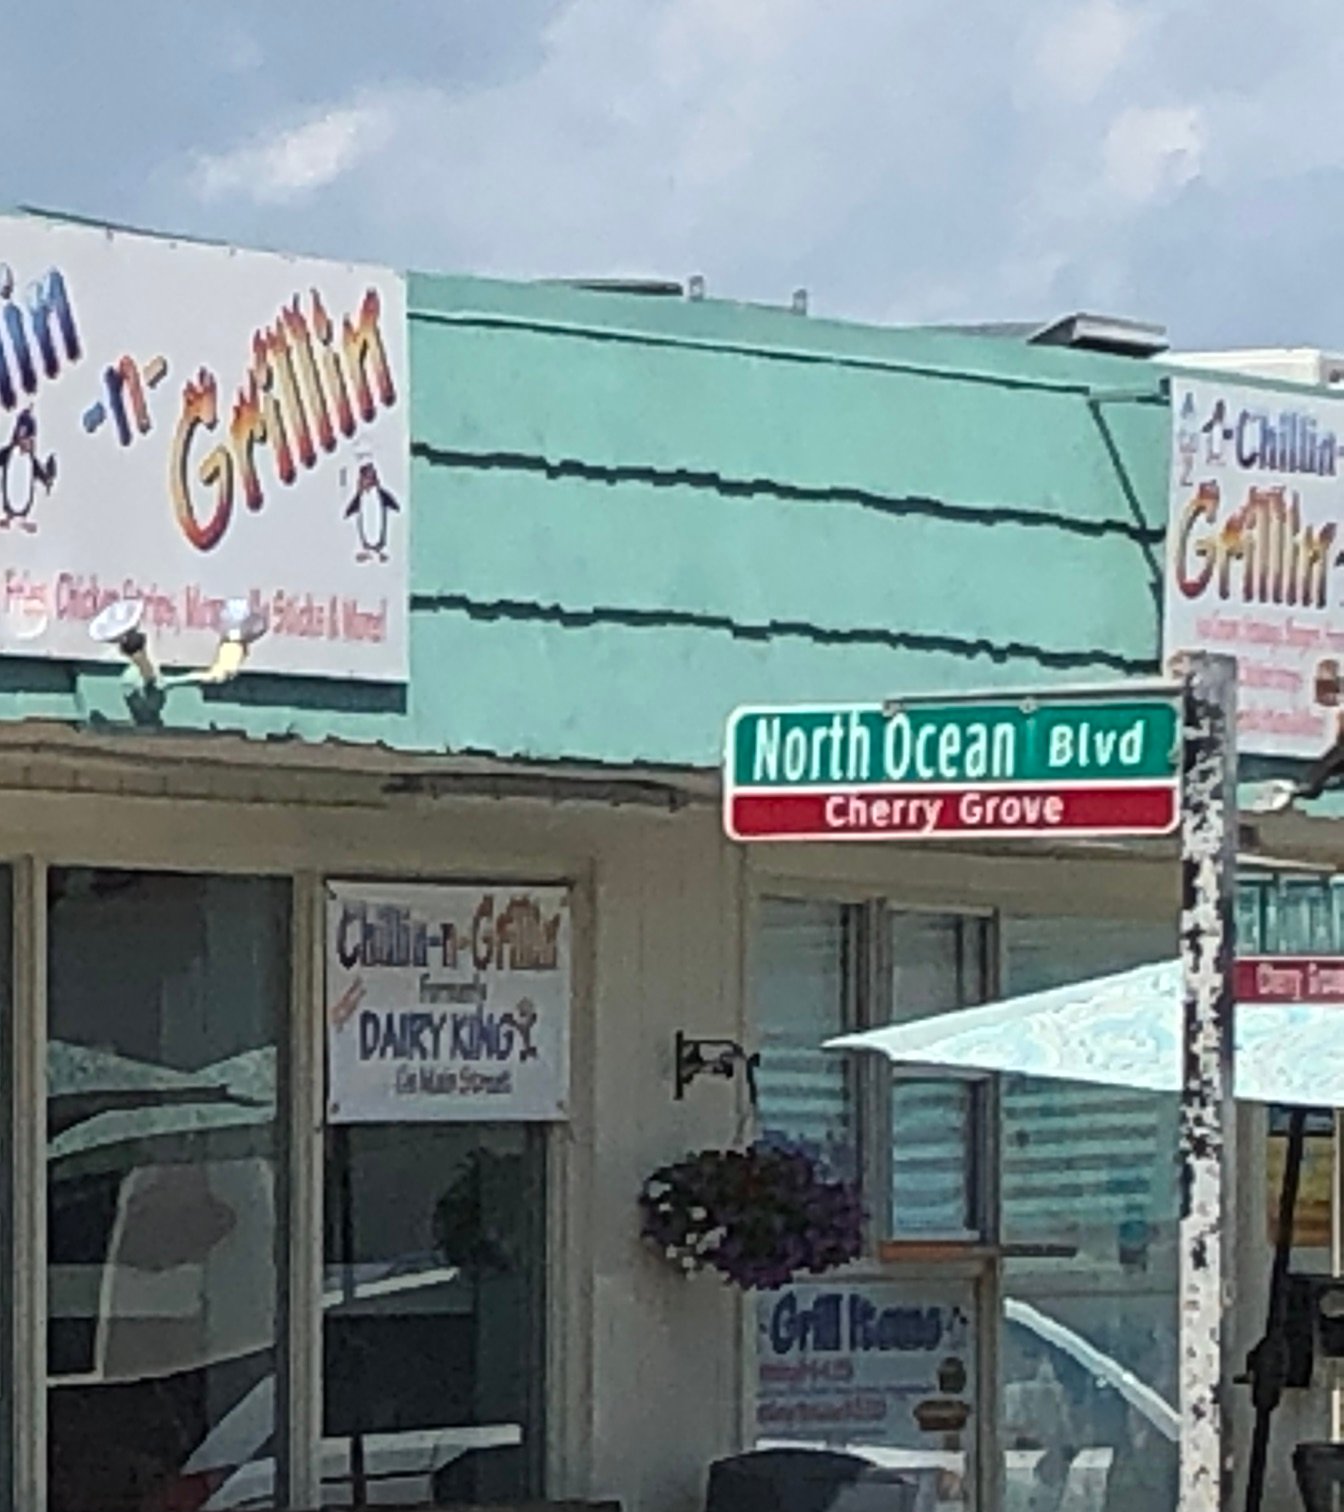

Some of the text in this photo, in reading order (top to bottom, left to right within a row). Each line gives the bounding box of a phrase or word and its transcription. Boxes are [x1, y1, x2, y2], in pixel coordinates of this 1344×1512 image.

[169, 287, 395, 552] Grillin
[1175, 480, 1338, 609] Grillin
[752, 710, 1145, 782] North Ocean Blvd
[824, 791, 1064, 833] Cherry Grove
[359, 1009, 514, 1061] DAIRY KING
